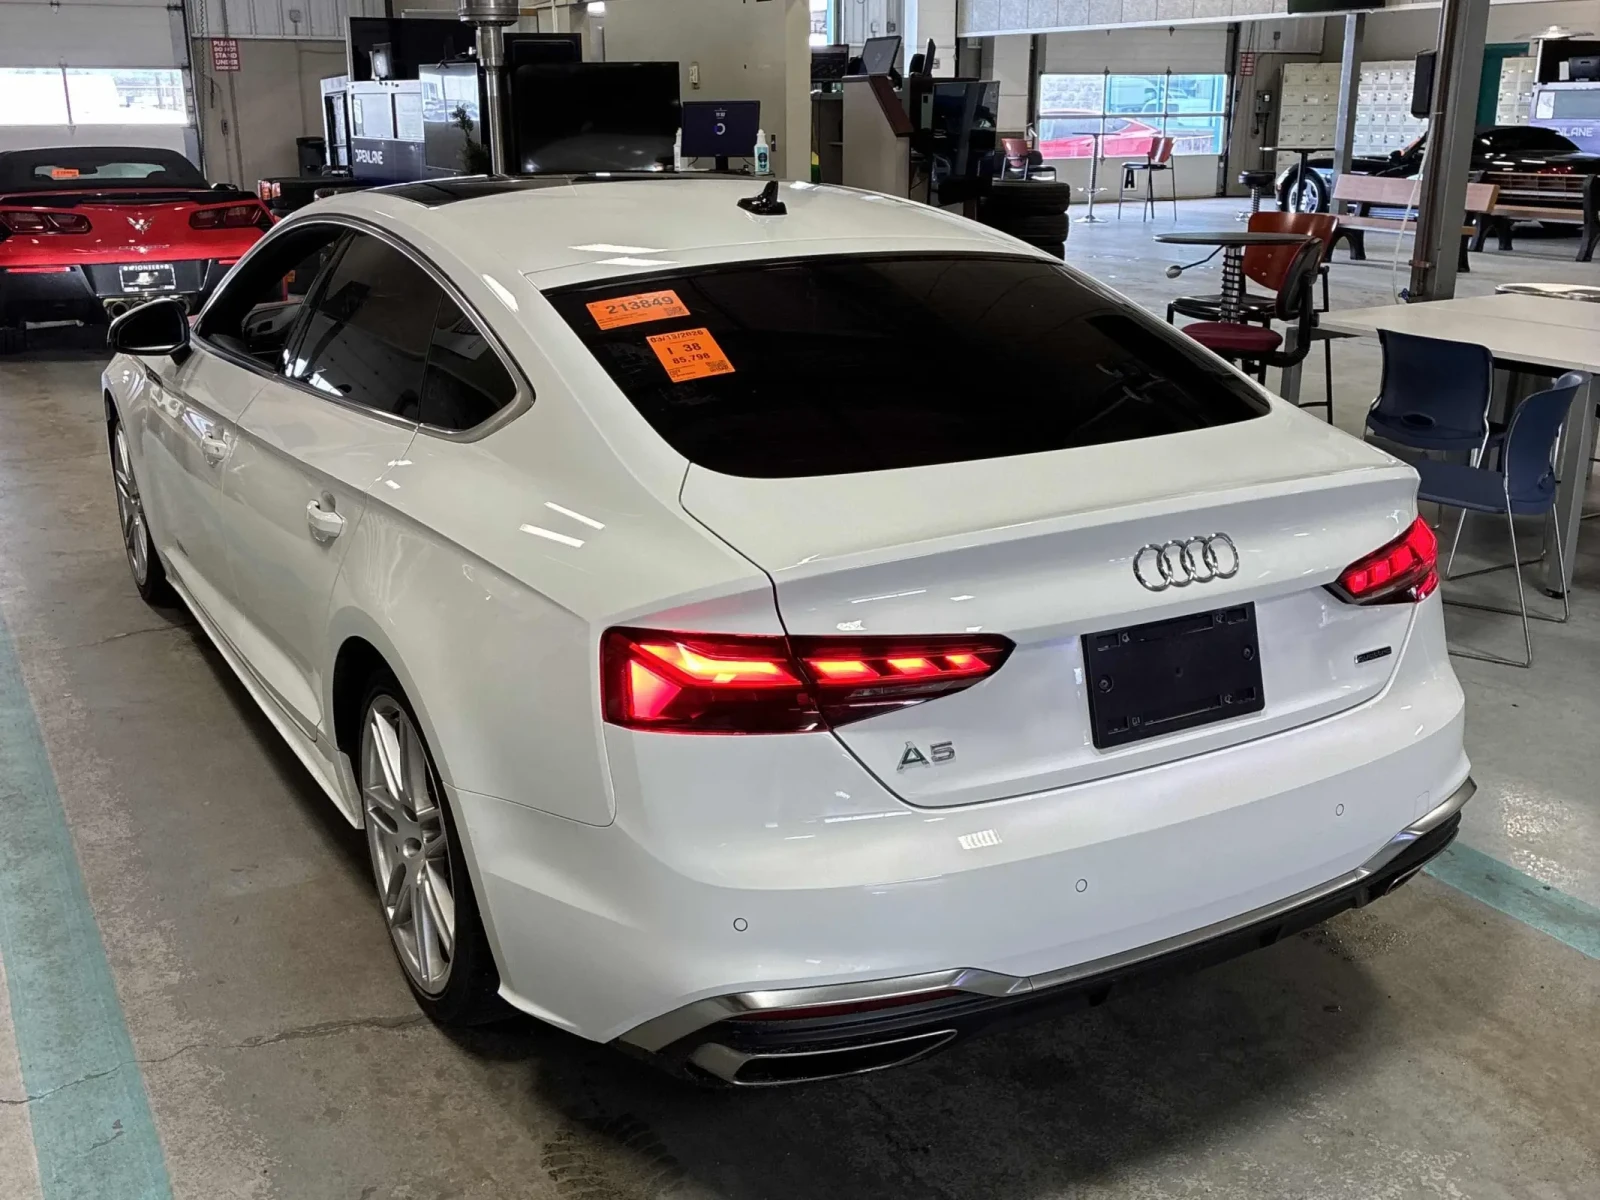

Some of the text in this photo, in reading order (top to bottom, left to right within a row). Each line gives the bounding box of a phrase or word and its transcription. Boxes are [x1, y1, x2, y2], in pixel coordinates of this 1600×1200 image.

[1124, 169, 1135, 188] A
[606, 296, 674, 314] 213849
[683, 343, 702, 352] 38
[896, 741, 956, 771] A5
